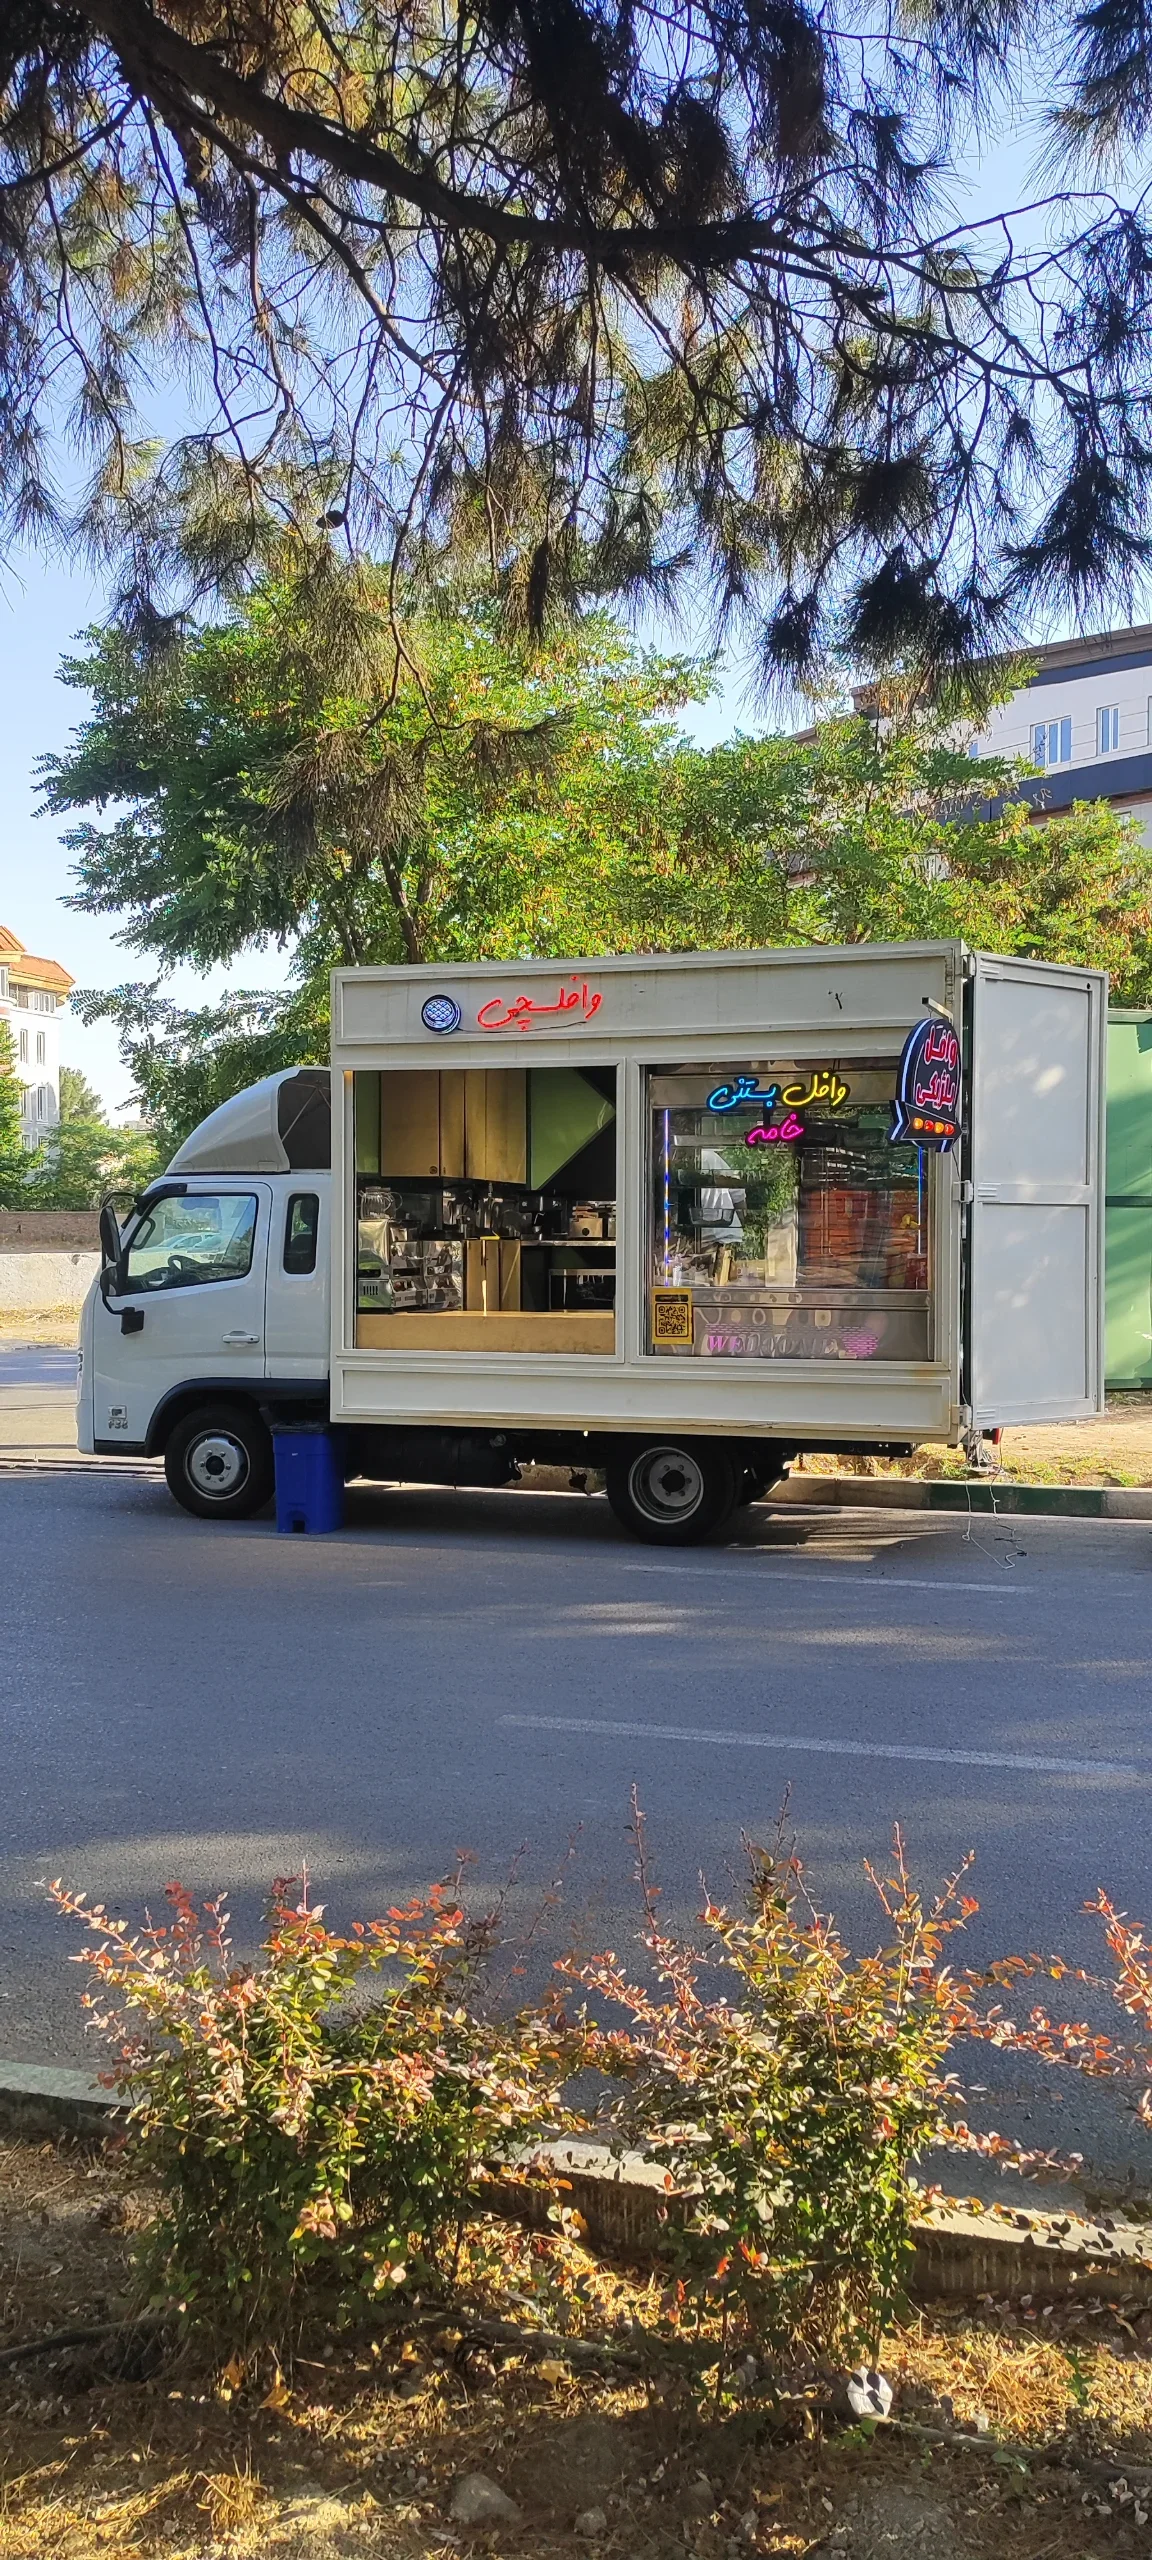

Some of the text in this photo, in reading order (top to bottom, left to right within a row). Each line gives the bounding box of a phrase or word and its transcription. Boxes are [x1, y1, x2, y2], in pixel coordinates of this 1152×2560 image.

[923, 1024, 958, 1071] وافل
[708, 1072, 847, 1110] وافل بستنی
[747, 1113, 804, 1145] خامه
